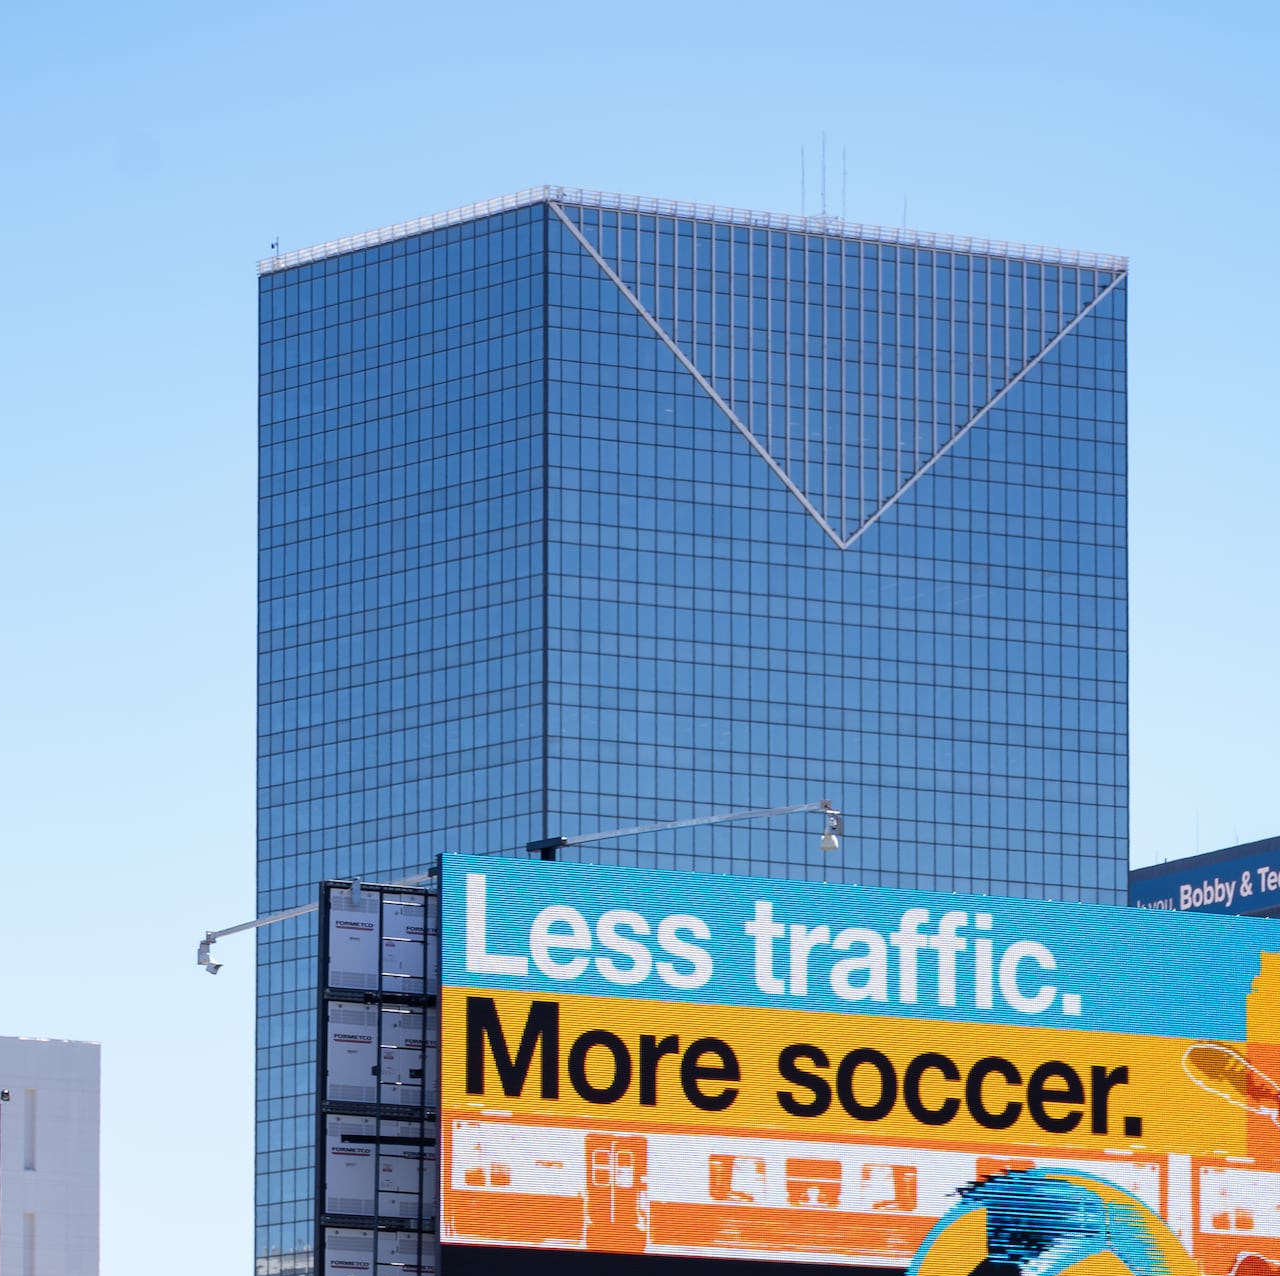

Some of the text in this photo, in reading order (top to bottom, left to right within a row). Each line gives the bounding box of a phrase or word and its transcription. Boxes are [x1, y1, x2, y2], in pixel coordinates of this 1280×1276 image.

[465, 874, 1082, 1016] Less traffic.
[1180, 878, 1236, 909] Bobby
[1239, 871, 1254, 898] &
[466, 996, 1143, 1138] More soccer.
